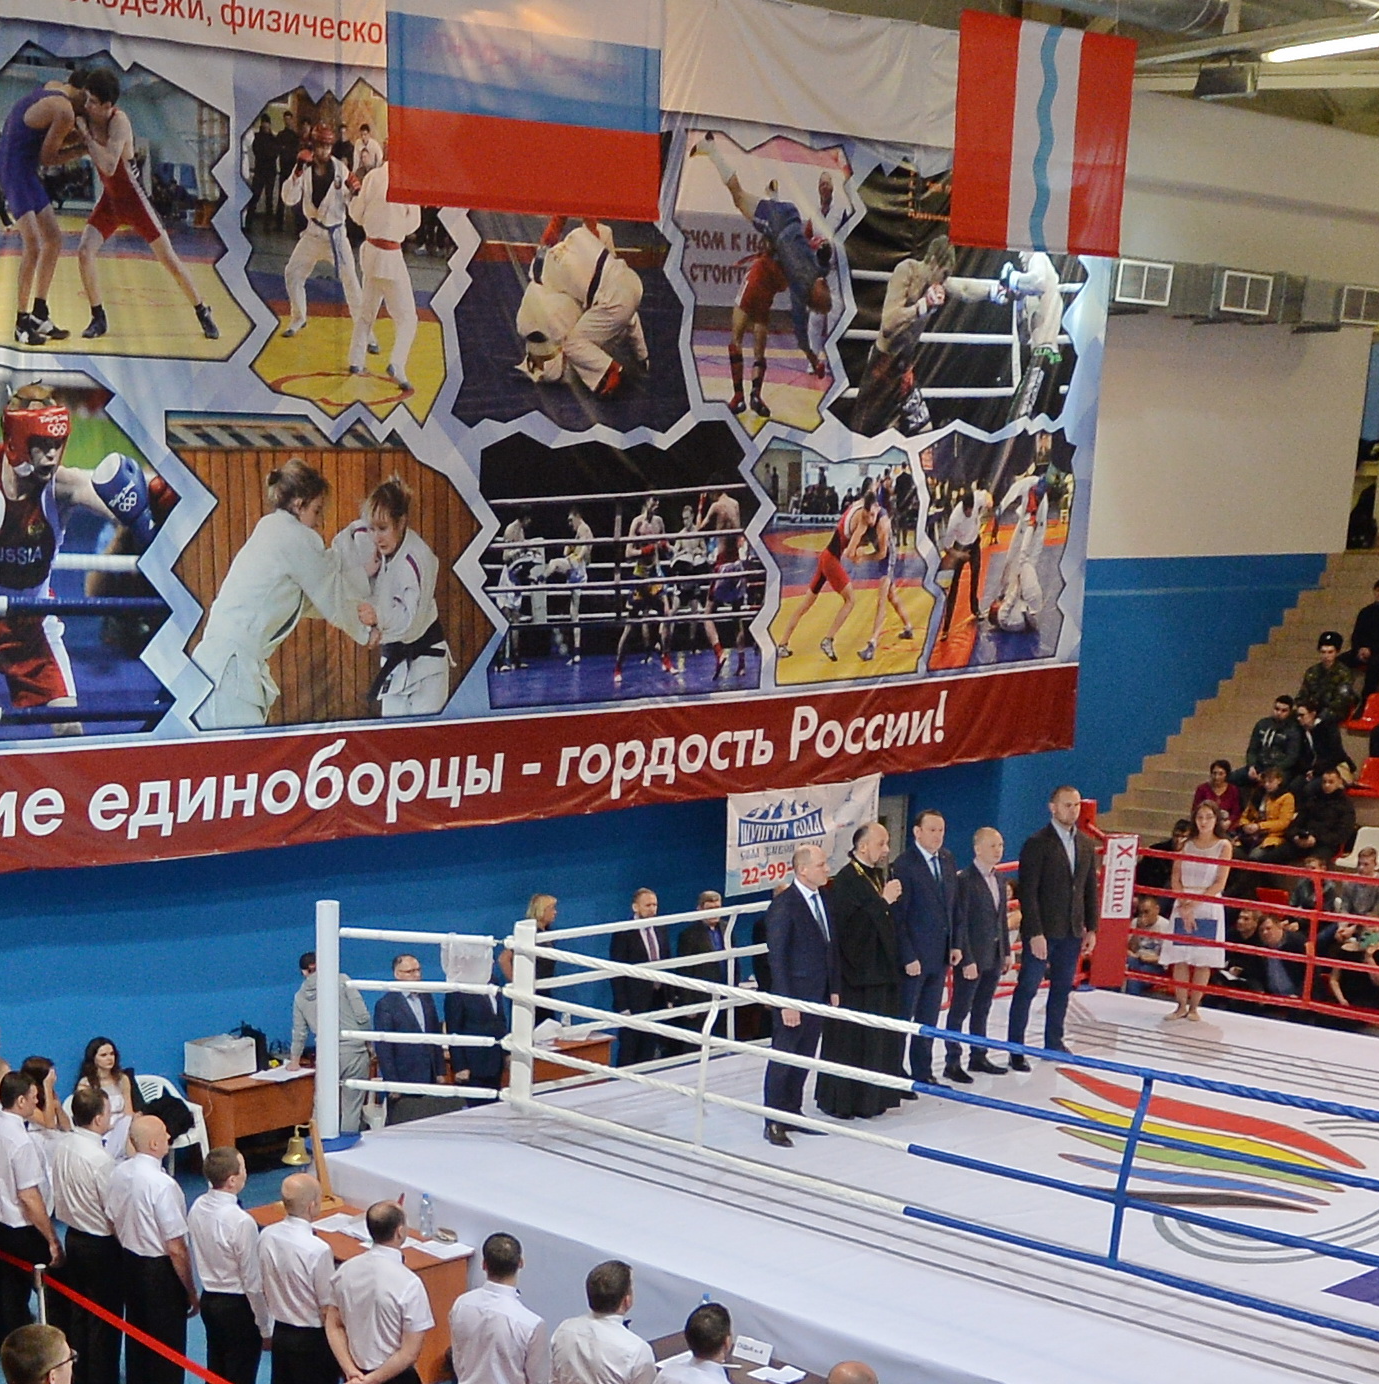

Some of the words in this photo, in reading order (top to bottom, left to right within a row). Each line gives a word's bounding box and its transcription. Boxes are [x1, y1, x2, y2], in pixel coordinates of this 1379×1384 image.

[87, 739, 505, 840] единоборцы
[555, 728, 774, 799] гордость
[789, 690, 949, 761] России!
[1111, 843, 1134, 913] X-time
